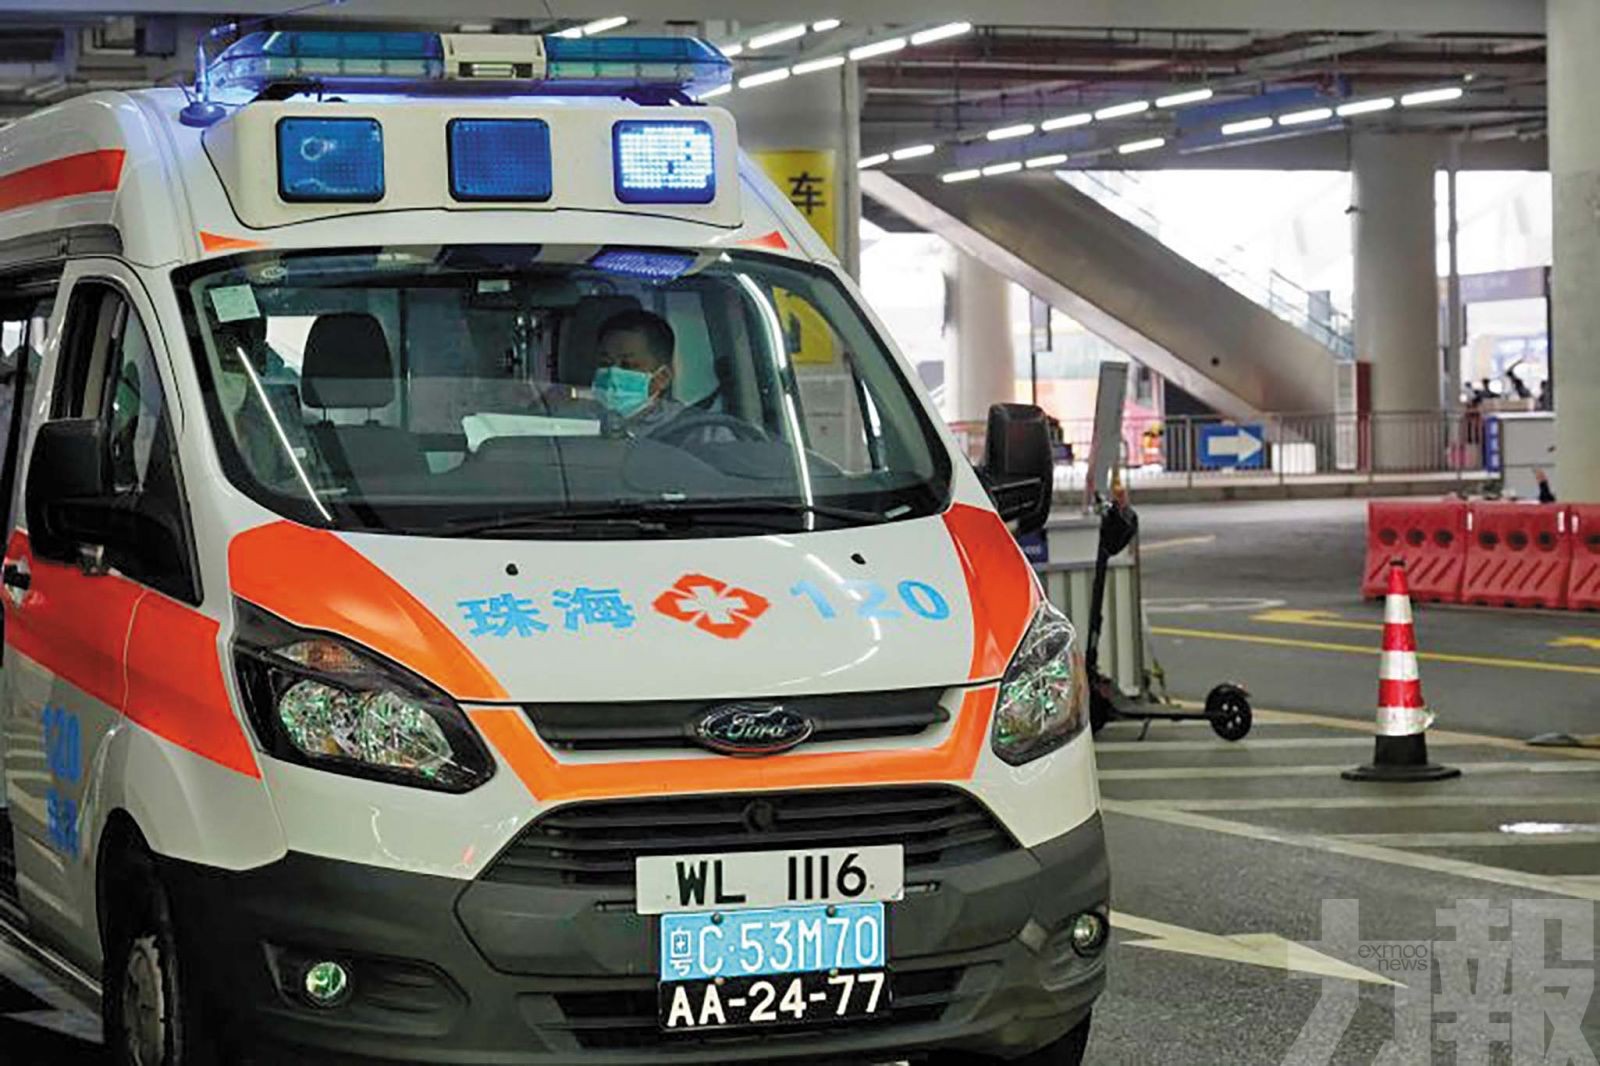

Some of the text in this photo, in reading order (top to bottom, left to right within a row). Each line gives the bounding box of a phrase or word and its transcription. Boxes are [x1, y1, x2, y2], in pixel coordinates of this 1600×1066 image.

[787, 171, 826, 215] 车
[456, 579, 950, 638] 珠海 120
[726, 706, 784, 739] Ford
[676, 853, 867, 906] WL 1116
[667, 973, 885, 1027] AA-24-77
